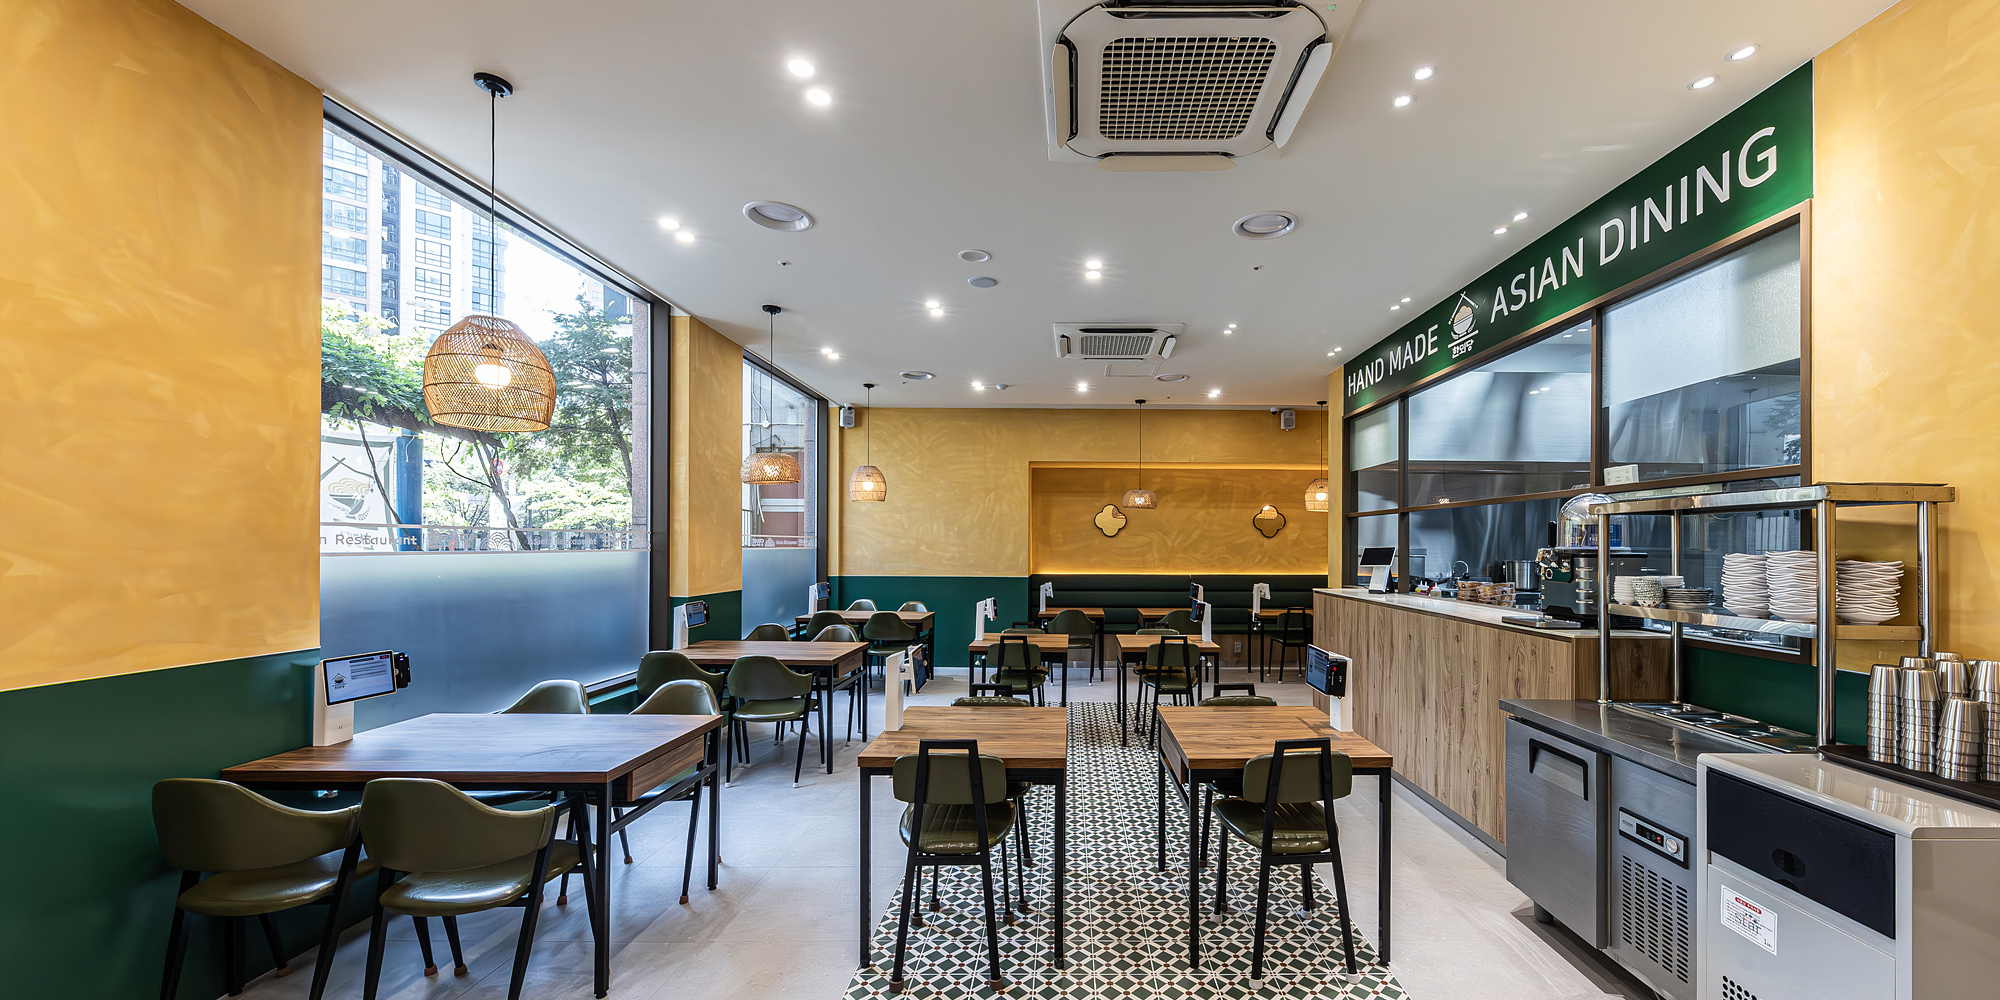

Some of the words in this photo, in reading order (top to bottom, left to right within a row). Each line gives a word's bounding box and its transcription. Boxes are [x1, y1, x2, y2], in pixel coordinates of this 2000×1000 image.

[1490, 236, 1584, 324] ASIAN
[1600, 126, 1778, 267] DINING
[1348, 357, 1384, 397] HAND
[1389, 323, 1439, 376] MADE
[335, 533, 418, 546] Restaurant
